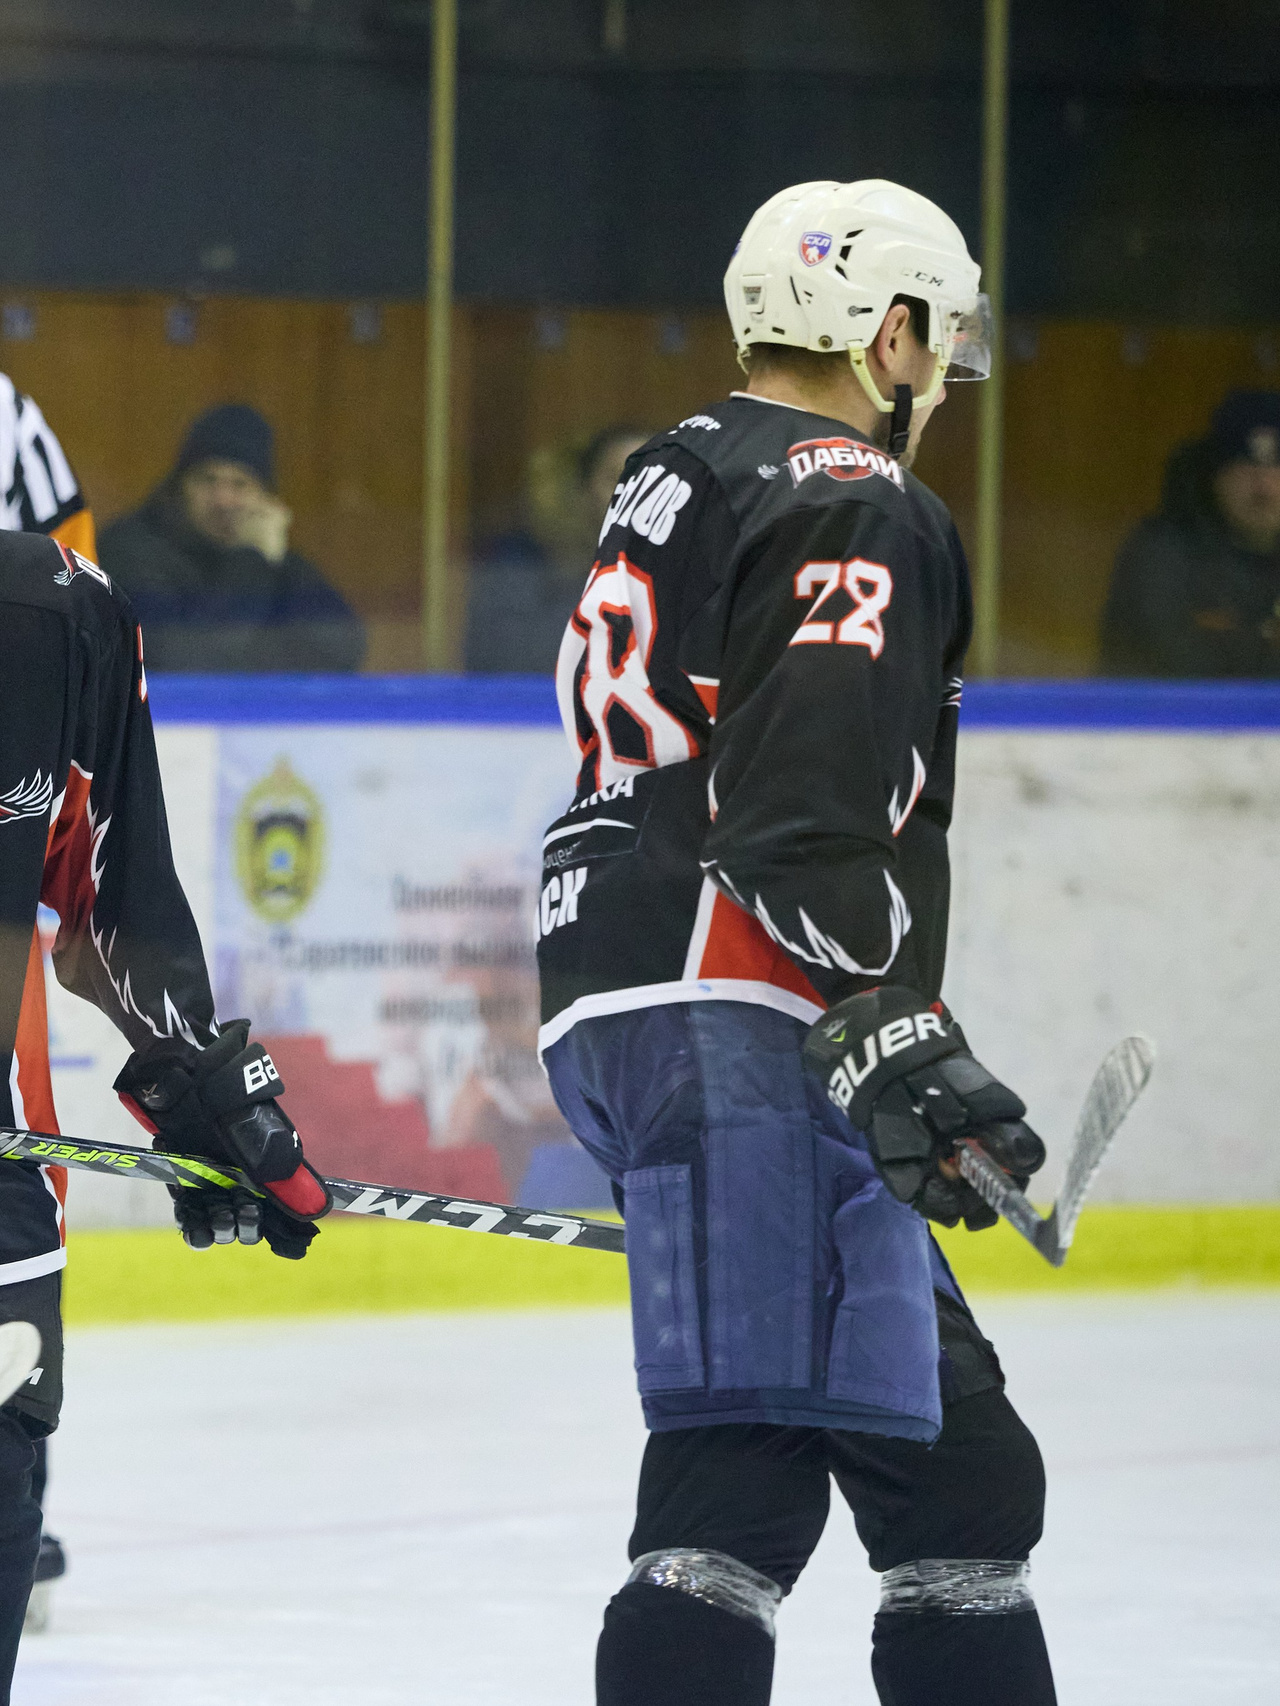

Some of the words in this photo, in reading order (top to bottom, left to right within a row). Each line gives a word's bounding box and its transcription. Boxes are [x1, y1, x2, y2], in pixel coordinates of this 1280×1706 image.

[787, 556, 894, 661] 28
[30, 1140, 141, 1169] SUPER
[344, 1187, 585, 1246] CCM
